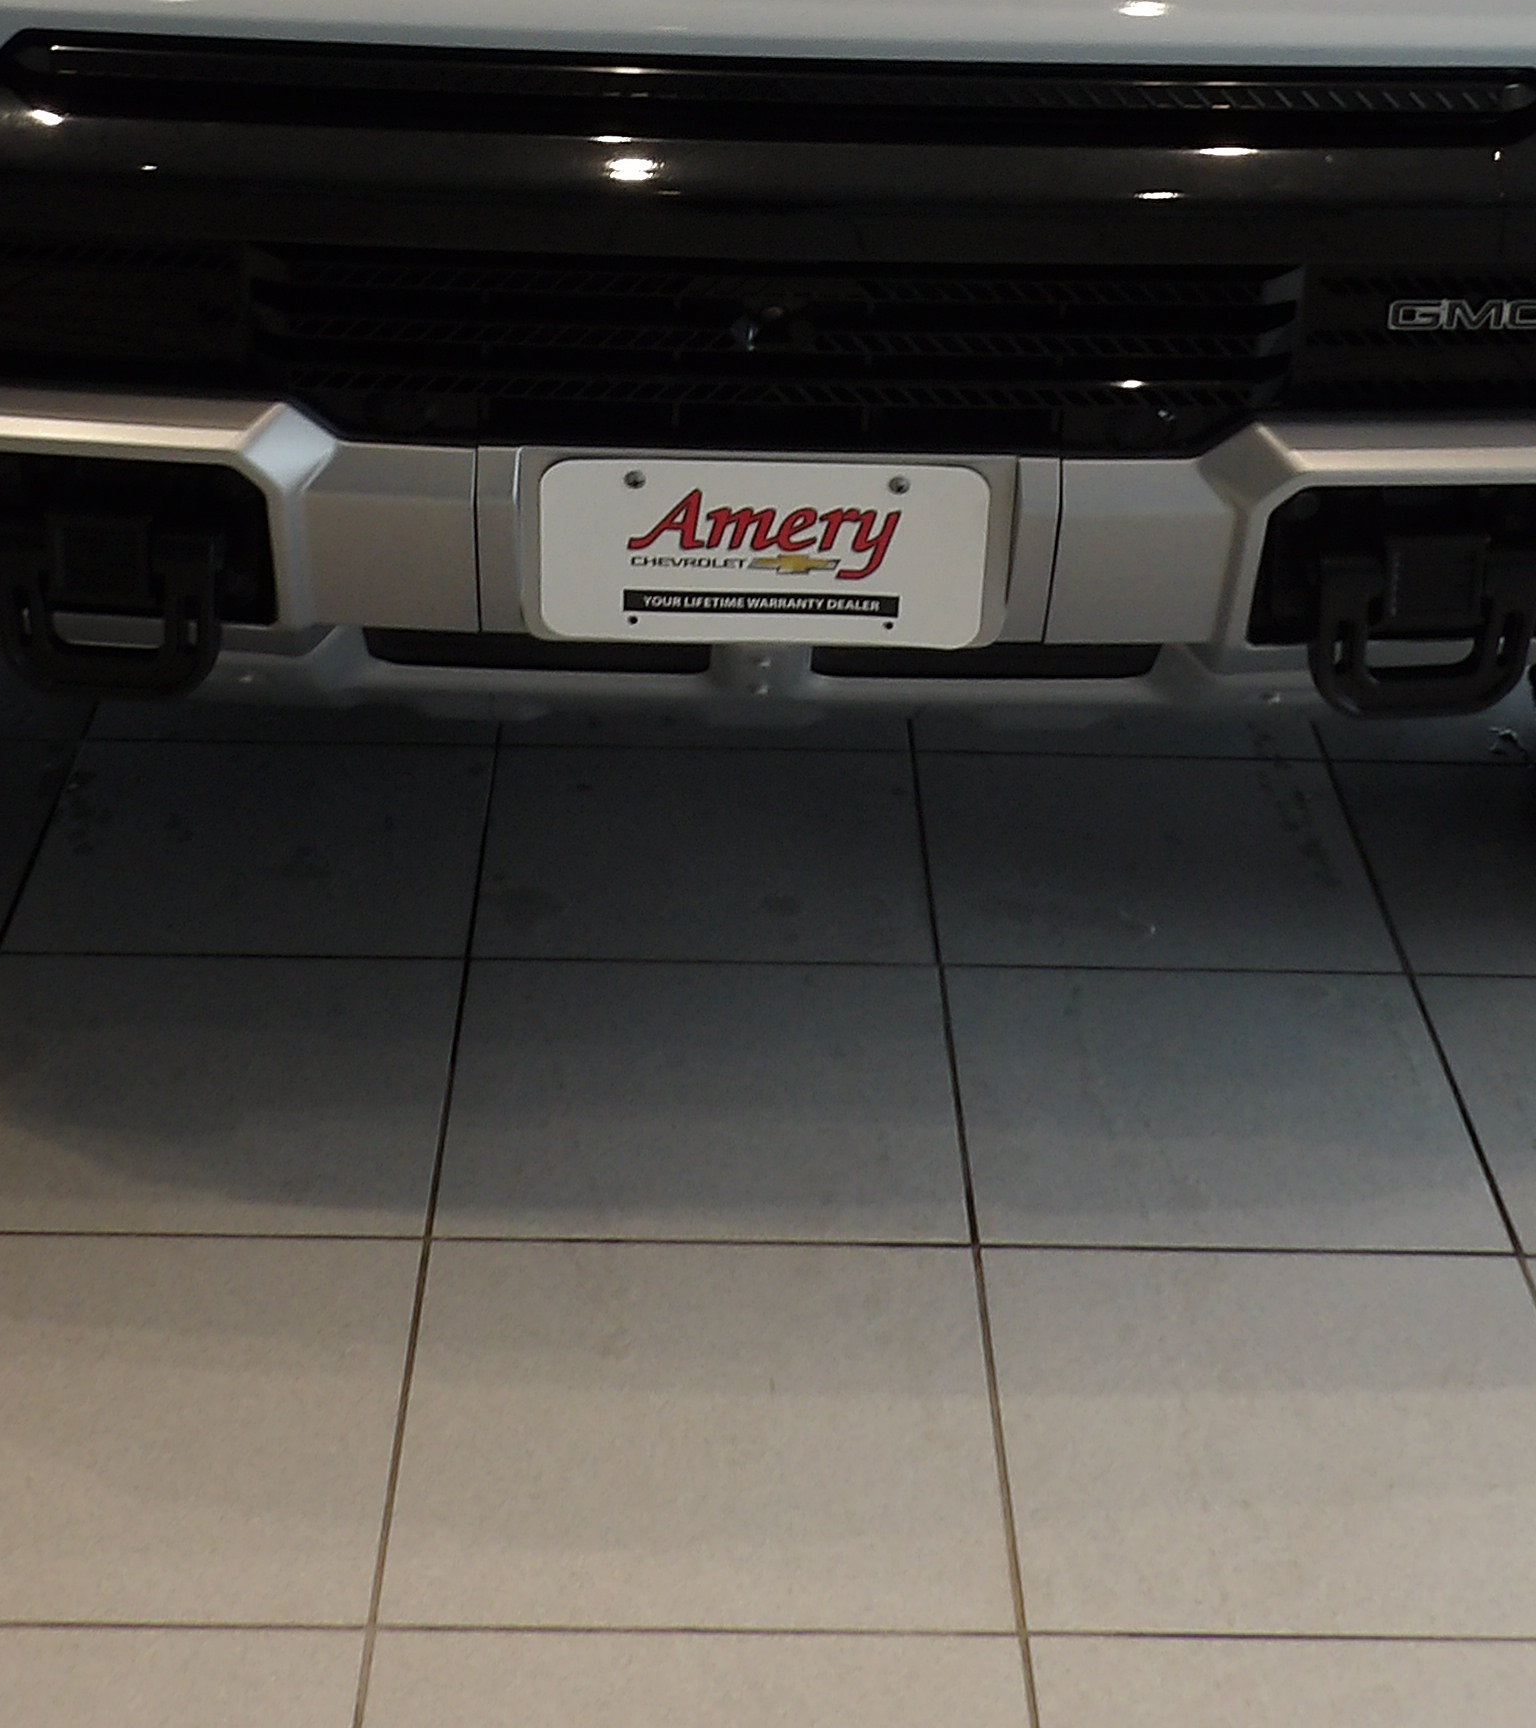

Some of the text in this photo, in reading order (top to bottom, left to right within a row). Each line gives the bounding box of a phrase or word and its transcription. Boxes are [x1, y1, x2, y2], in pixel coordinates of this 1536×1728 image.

[627, 488, 902, 579] Amery
[631, 556, 746, 569] CHEVROLET
[644, 595, 880, 611] YOUR LIFETIME WARRANTY DEALER
